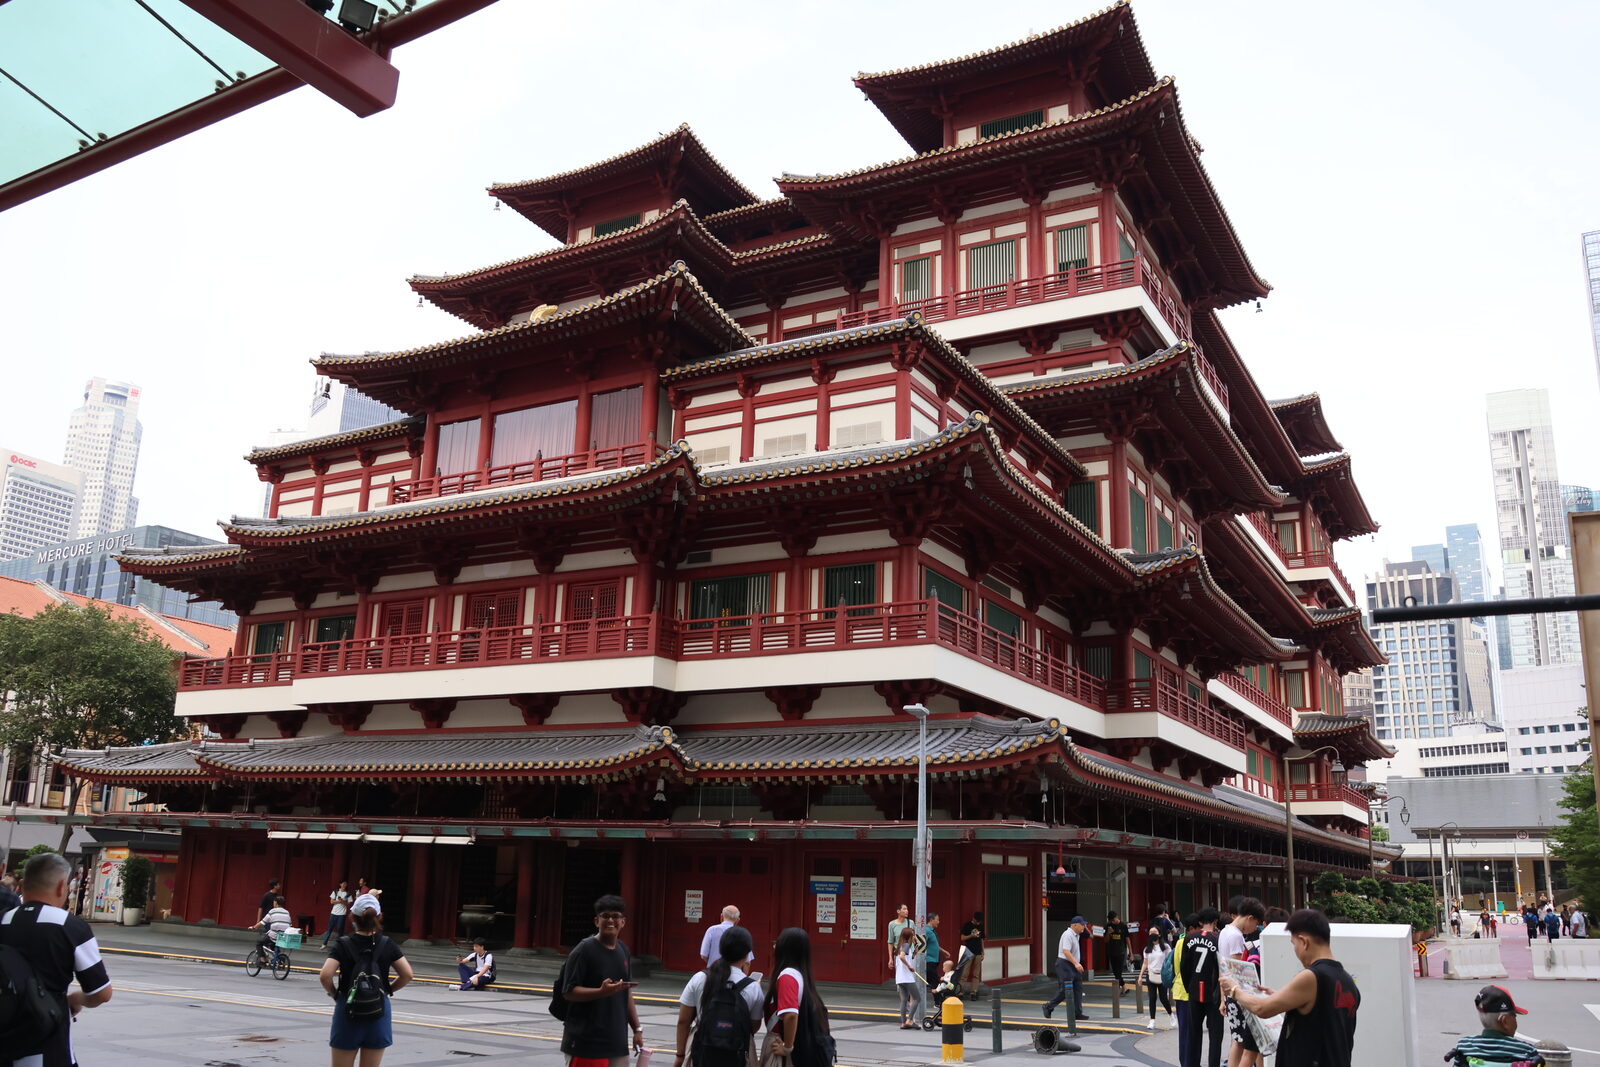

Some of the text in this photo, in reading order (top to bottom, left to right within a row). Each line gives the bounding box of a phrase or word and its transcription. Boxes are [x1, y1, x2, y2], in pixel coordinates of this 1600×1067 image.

[37, 533, 135, 564] MERCURE HOTEL
[1187, 937, 1217, 952] RONALDO
[1195, 946, 1209, 973] 7
